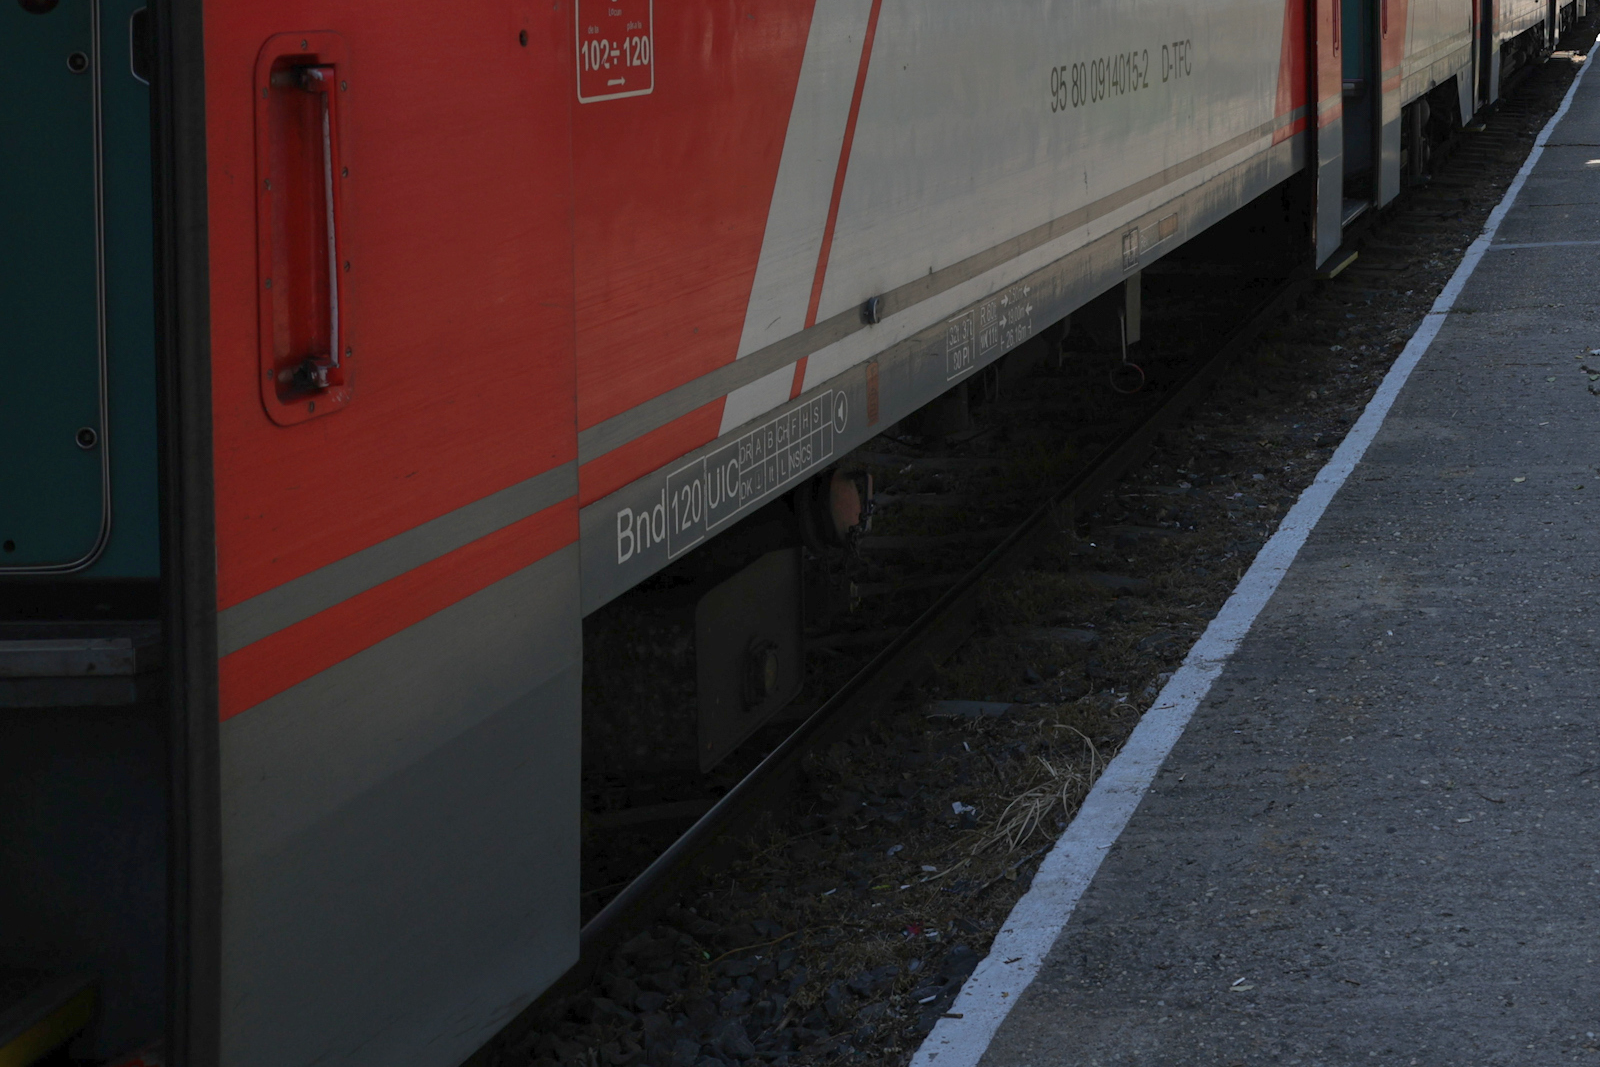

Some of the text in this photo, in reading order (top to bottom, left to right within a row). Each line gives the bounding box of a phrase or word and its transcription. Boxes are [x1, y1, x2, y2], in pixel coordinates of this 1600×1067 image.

[1050, 39, 1192, 113] 95 80 0914015-2 D-TFC
[980, 306, 986, 326] R
[740, 407, 819, 464] DR A B CH F H S
[740, 477, 753, 500] DK
[781, 460, 786, 476] L
[790, 450, 800, 470] NS
[801, 444, 811, 463] CS
[617, 458, 739, 565] Bnd 120 UIC
